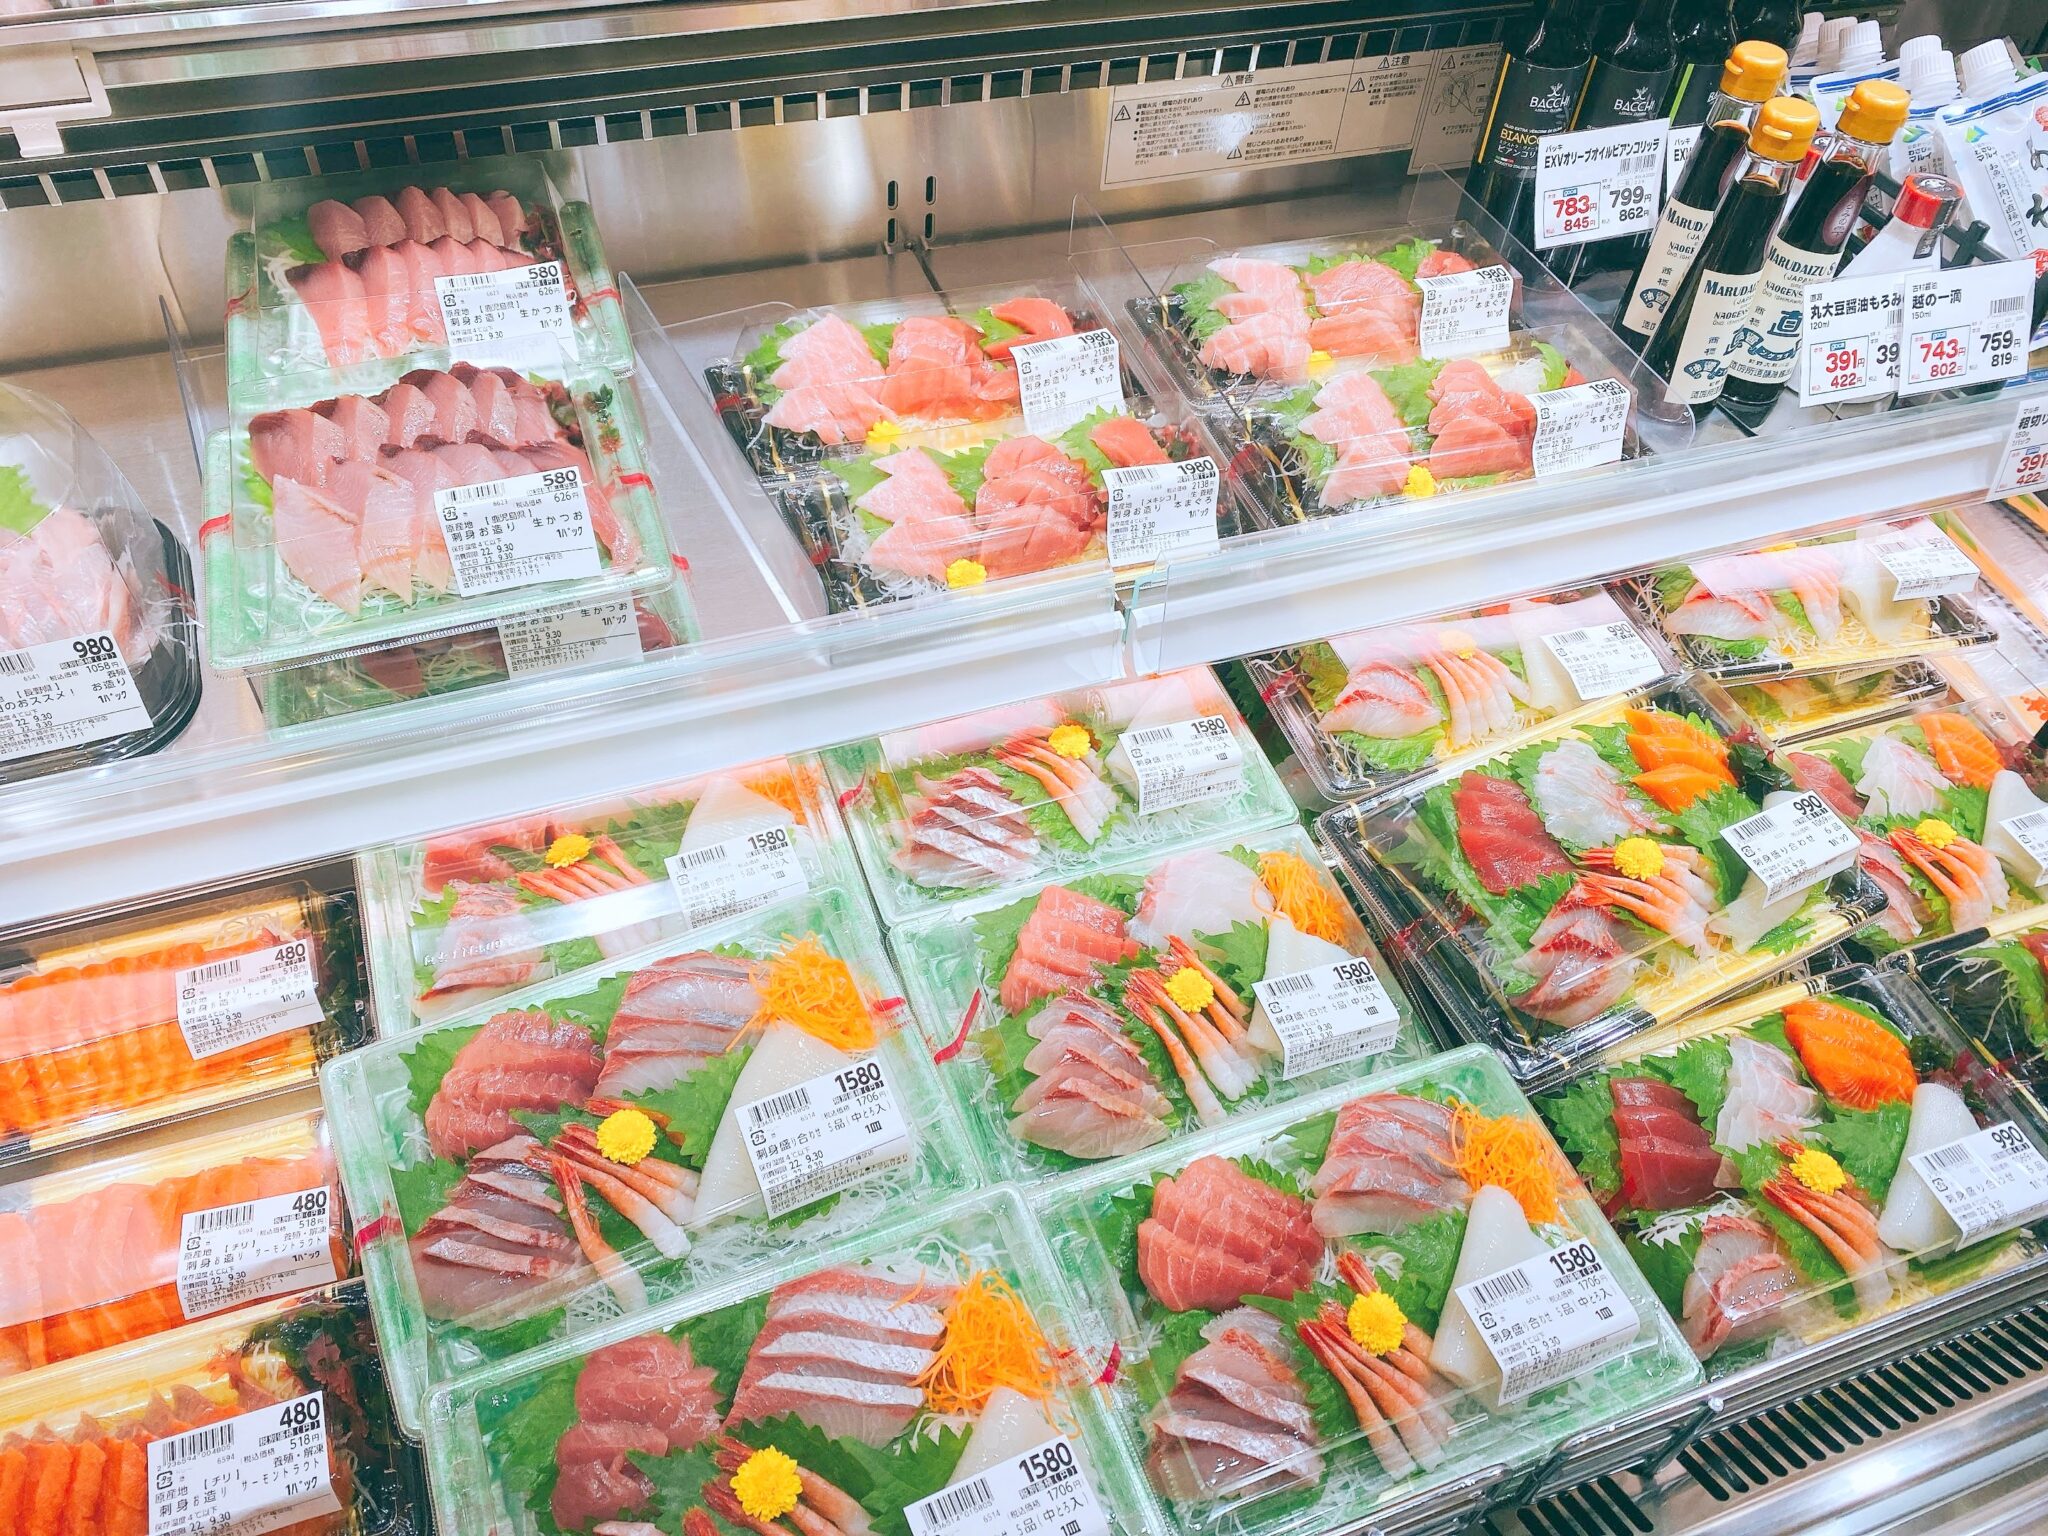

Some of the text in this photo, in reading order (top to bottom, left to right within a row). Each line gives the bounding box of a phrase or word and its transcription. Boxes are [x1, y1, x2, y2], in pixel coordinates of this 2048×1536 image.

[1391, 56, 1410, 66] 注意
[1235, 75, 1254, 85] 警告
[1530, 96, 1570, 108] BACCHI
[1614, 99, 1655, 112] BACCHI
[1544, 138, 1660, 169] EXVオリーブオイルビアンコリッラ
[1609, 185, 1652, 209] 799円
[1553, 195, 1598, 219] 783円
[1619, 205, 1650, 222] 862円
[1563, 215, 1596, 232] 845円
[528, 264, 558, 280] 580
[1476, 267, 1507, 280] 1980
[538, 287, 560, 296] 626円
[1912, 289, 1962, 309] 越の一滴
[1810, 292, 1904, 320] 丸大豆醤油もろみ
[450, 304, 562, 326] 刺身お造り 生かつお
[1078, 331, 1111, 345] 1980
[1980, 330, 2021, 353] 759円
[1920, 338, 1966, 363] 743円
[1825, 349, 1865, 373] 391円
[1991, 352, 2018, 367] 819円
[1930, 361, 1963, 378] 802円
[1589, 381, 1622, 394] 1980
[1830, 372, 1863, 389] 422円
[1177, 459, 1214, 475] 1980
[2017, 452, 2048, 474] 391
[543, 470, 577, 487] 580
[554, 492, 579, 503] 626円
[1175, 497, 1212, 508] 本まぐろ
[445, 521, 474, 533] 原産地
[451, 511, 583, 542] 刺身お造り 生かつお
[1143, 521, 1156, 529] 9.30
[497, 543, 514, 554] 9.30
[498, 552, 513, 561] 9.30
[580, 602, 628, 618] 生かつお
[545, 630, 562, 640] 9.30
[1607, 624, 1631, 636] 990
[73, 635, 114, 658] 980
[86, 661, 120, 673] 1058円
[92, 678, 126, 692] お造り
[33, 713, 52, 722] 9.30
[1191, 717, 1225, 734] 1580
[1793, 795, 1822, 816] 990
[748, 828, 786, 850] 1580
[275, 943, 305, 962] 480
[1333, 961, 1370, 980] 1580
[226, 1012, 242, 1023] 9.30
[1318, 1022, 1333, 1032] 9.30
[834, 1062, 881, 1092] 1580
[756, 1128, 821, 1160] 刺身盛り合わせ
[1992, 1126, 2024, 1149] 990
[805, 1150, 824, 1164] 9.30
[292, 1191, 327, 1212] 480
[184, 1249, 212, 1260] 原産地
[186, 1238, 322, 1271] 刺身お造り サーモントラウト
[1550, 1243, 1596, 1276] 1580
[228, 1271, 247, 1281] 9.30
[1489, 1312, 1553, 1345] 刺身盛り合わせ
[1542, 1336, 1561, 1349] 9.30
[279, 1397, 320, 1428] 480
[273, 1444, 325, 1468] 養殖・解凍
[1018, 1442, 1072, 1483] 1580
[155, 1485, 189, 1504] 原産地
[159, 1457, 319, 1517] 刺身お造り サーモントラウト
[209, 1511, 231, 1525] 9.30
